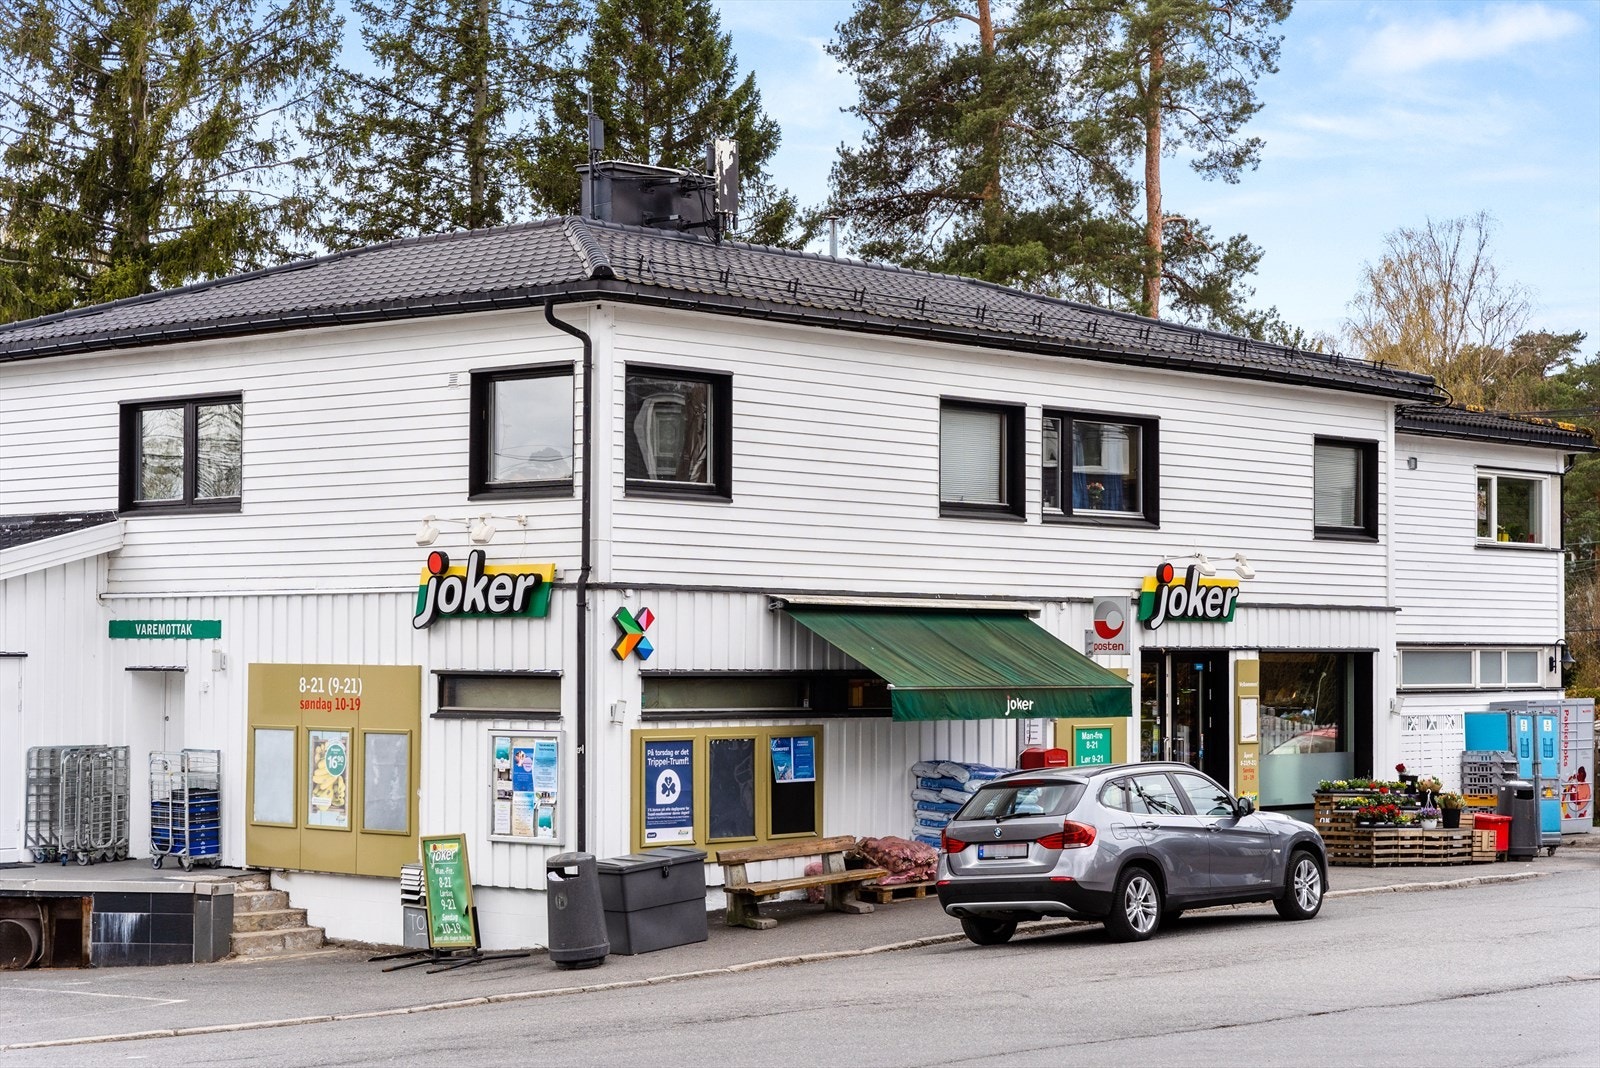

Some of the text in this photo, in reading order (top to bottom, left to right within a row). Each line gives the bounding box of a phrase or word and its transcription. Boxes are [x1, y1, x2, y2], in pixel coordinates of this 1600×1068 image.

[413, 549, 542, 629] joker
[1144, 563, 1240, 630] joker
[135, 623, 193, 636] VAREMOTTAK
[1093, 642, 1124, 651] posten
[299, 676, 363, 697] 8-21 (9-21)
[299, 696, 361, 713] søndag 10-19
[1004, 695, 1034, 716] joker
[1081, 731, 1103, 740] Man-fre
[1085, 741, 1098, 749] 8-21
[647, 748, 655, 756] På
[655, 749, 674, 757] torsdag
[680, 748, 689, 756] det
[647, 757, 690, 767] Trippel-Trumf!
[1080, 755, 1104, 764] Lør 9-21
[430, 843, 456, 869] joker
[438, 876, 452, 888] 8-21
[440, 899, 457, 910] 9-21
[440, 923, 462, 934] 10-19
